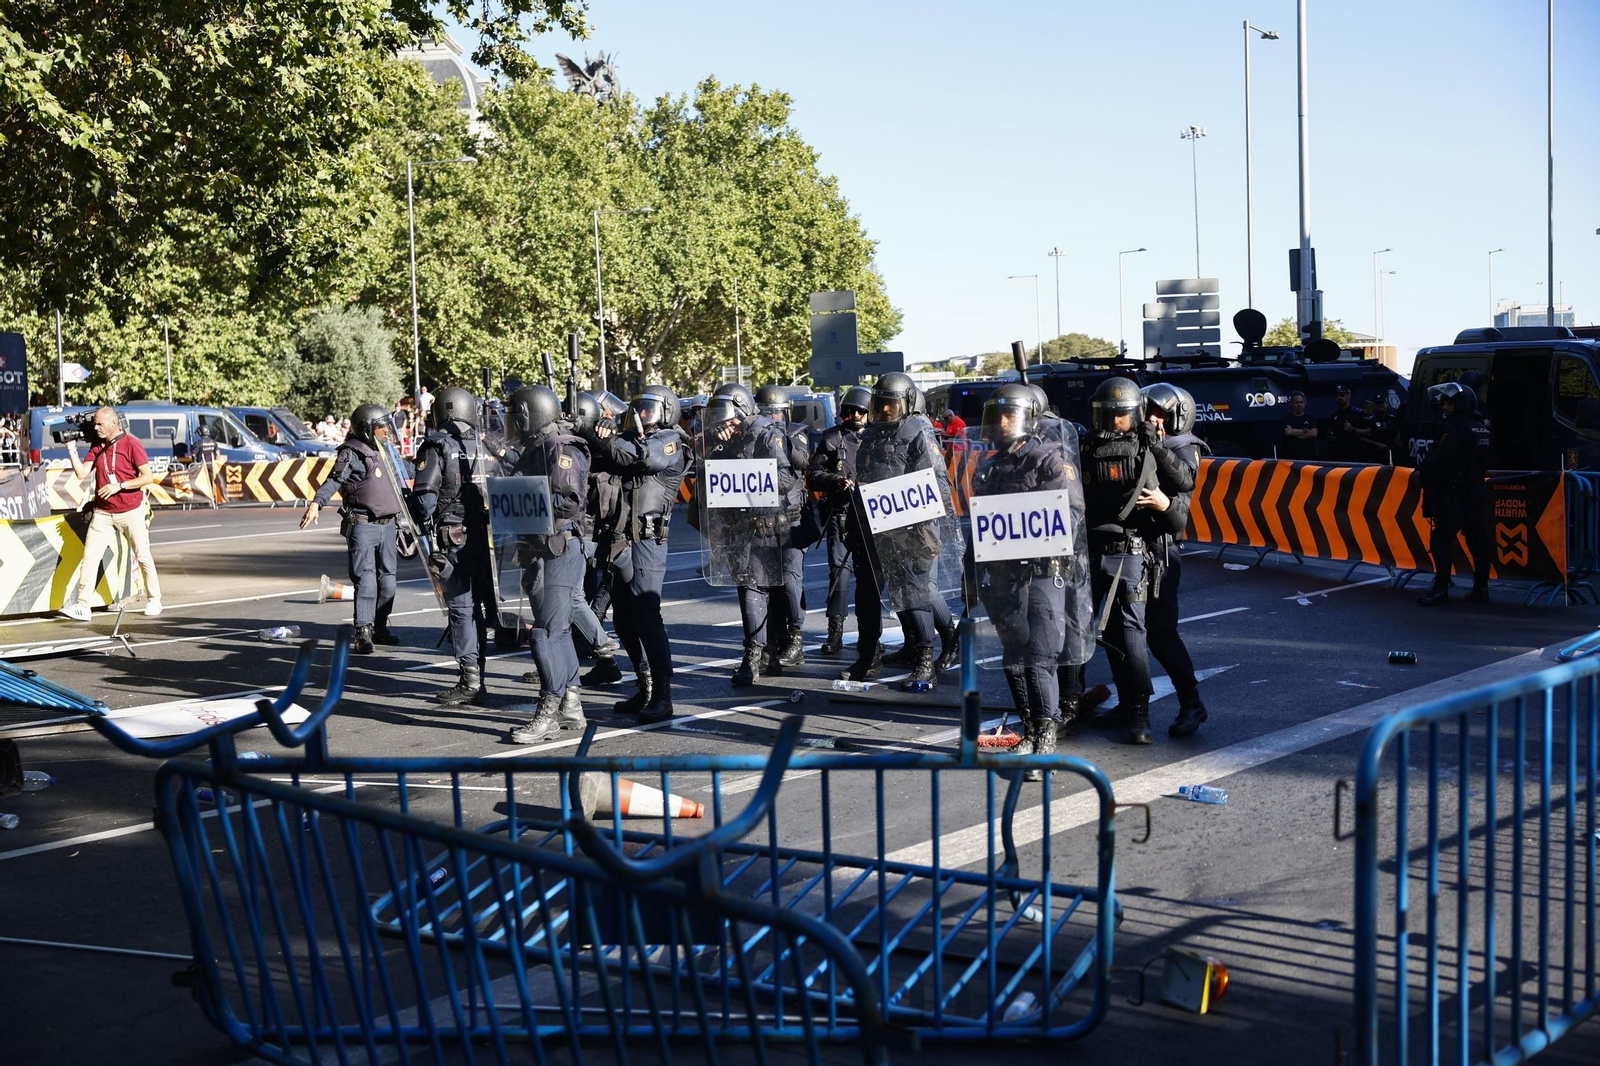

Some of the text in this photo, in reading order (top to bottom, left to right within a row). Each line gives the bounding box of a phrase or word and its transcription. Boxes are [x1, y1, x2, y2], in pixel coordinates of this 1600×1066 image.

[709, 471, 775, 494] POLICIA
[491, 492, 549, 518] POLICIA
[867, 483, 938, 519] POLICIA
[1495, 499, 1526, 508] MODYF
[976, 509, 1067, 543] POLICIA
